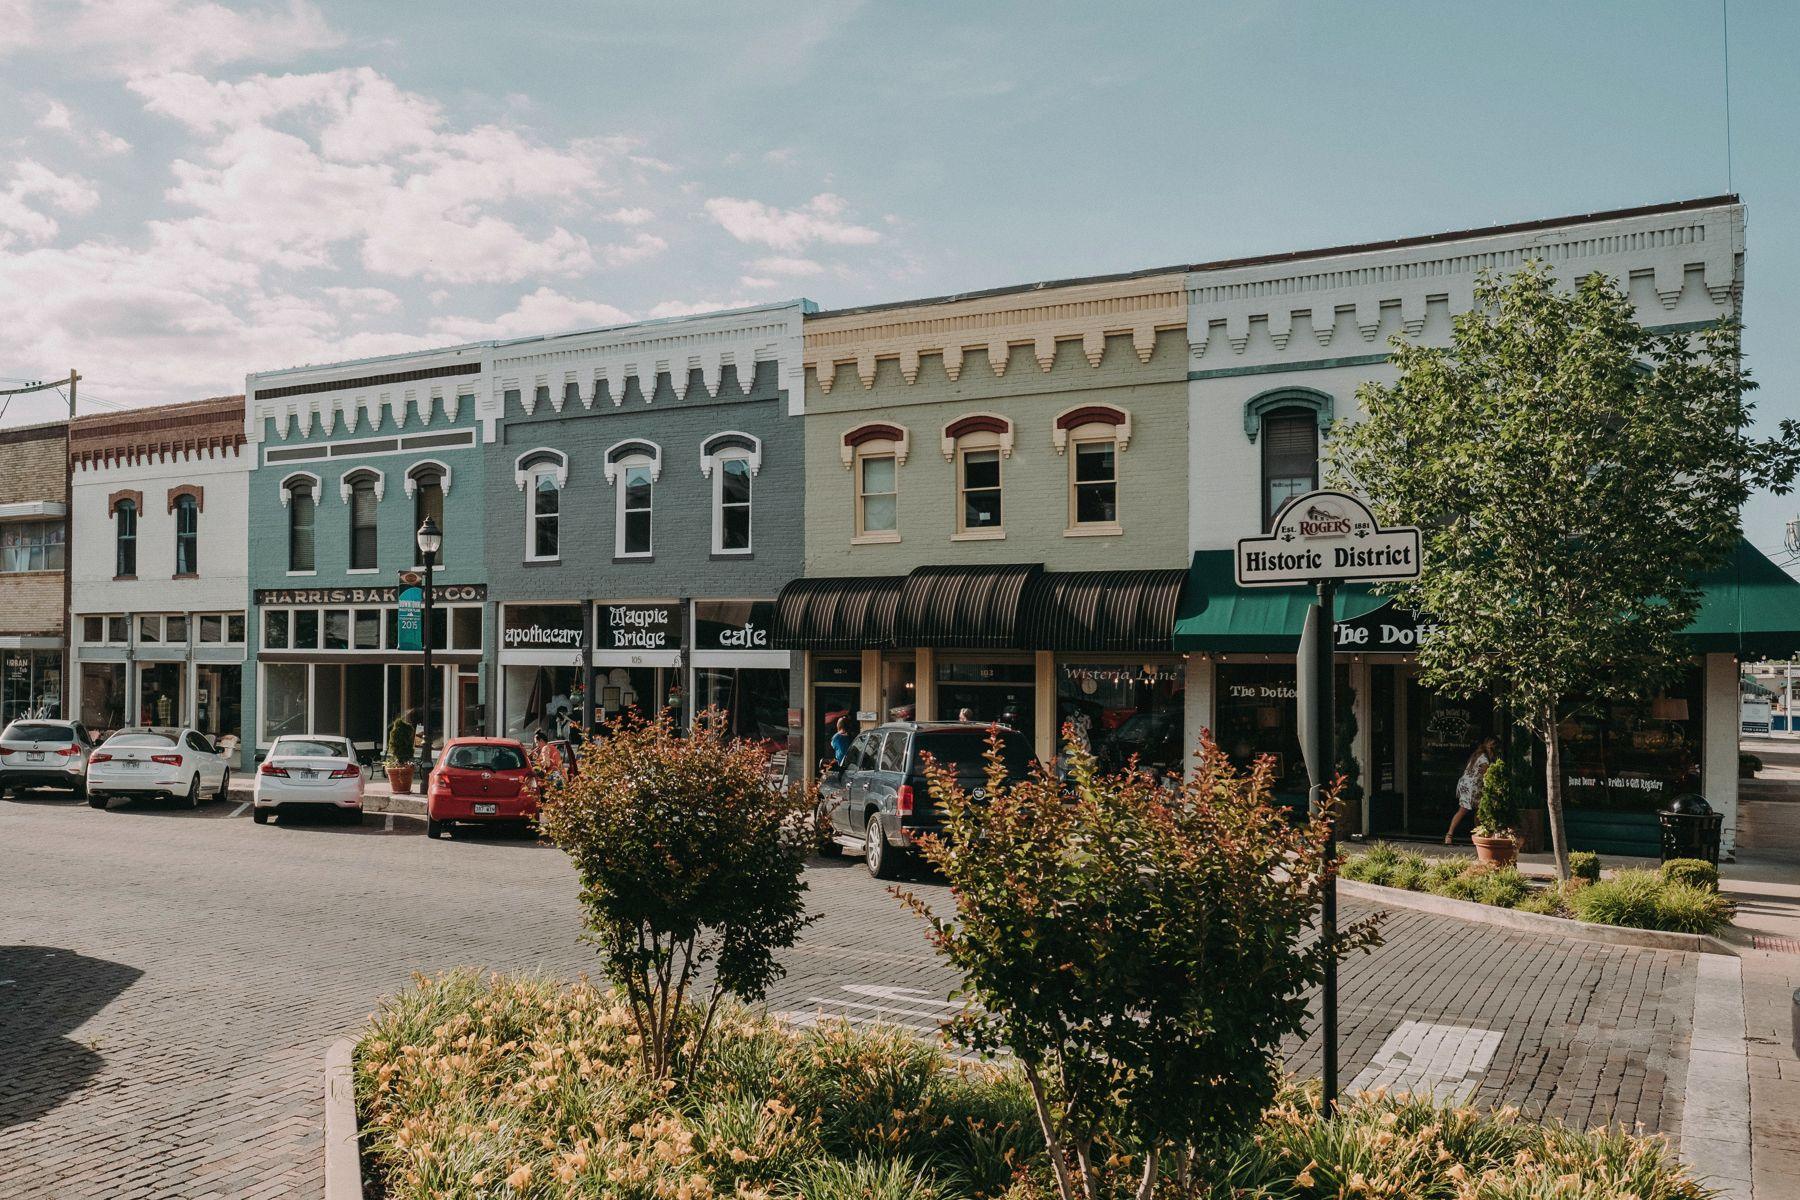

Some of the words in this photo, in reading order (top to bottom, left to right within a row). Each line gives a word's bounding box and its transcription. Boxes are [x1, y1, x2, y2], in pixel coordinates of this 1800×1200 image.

[1299, 520, 1352, 537] ROGERS
[1354, 523, 1370, 531] 1881
[1246, 550, 1322, 572] Historic
[1334, 545, 1412, 568] District
[264, 589, 346, 605] HARRIS
[609, 606, 668, 627] Magpie
[504, 624, 583, 647] apothecary
[613, 629, 666, 649] Bridge
[719, 622, 767, 648] cafe
[631, 656, 643, 664] 105
[1065, 667, 1130, 680] Wisteria
[1135, 670, 1178, 681] Lane
[1229, 685, 1256, 697] The
[1640, 779, 1664, 792] Registry
